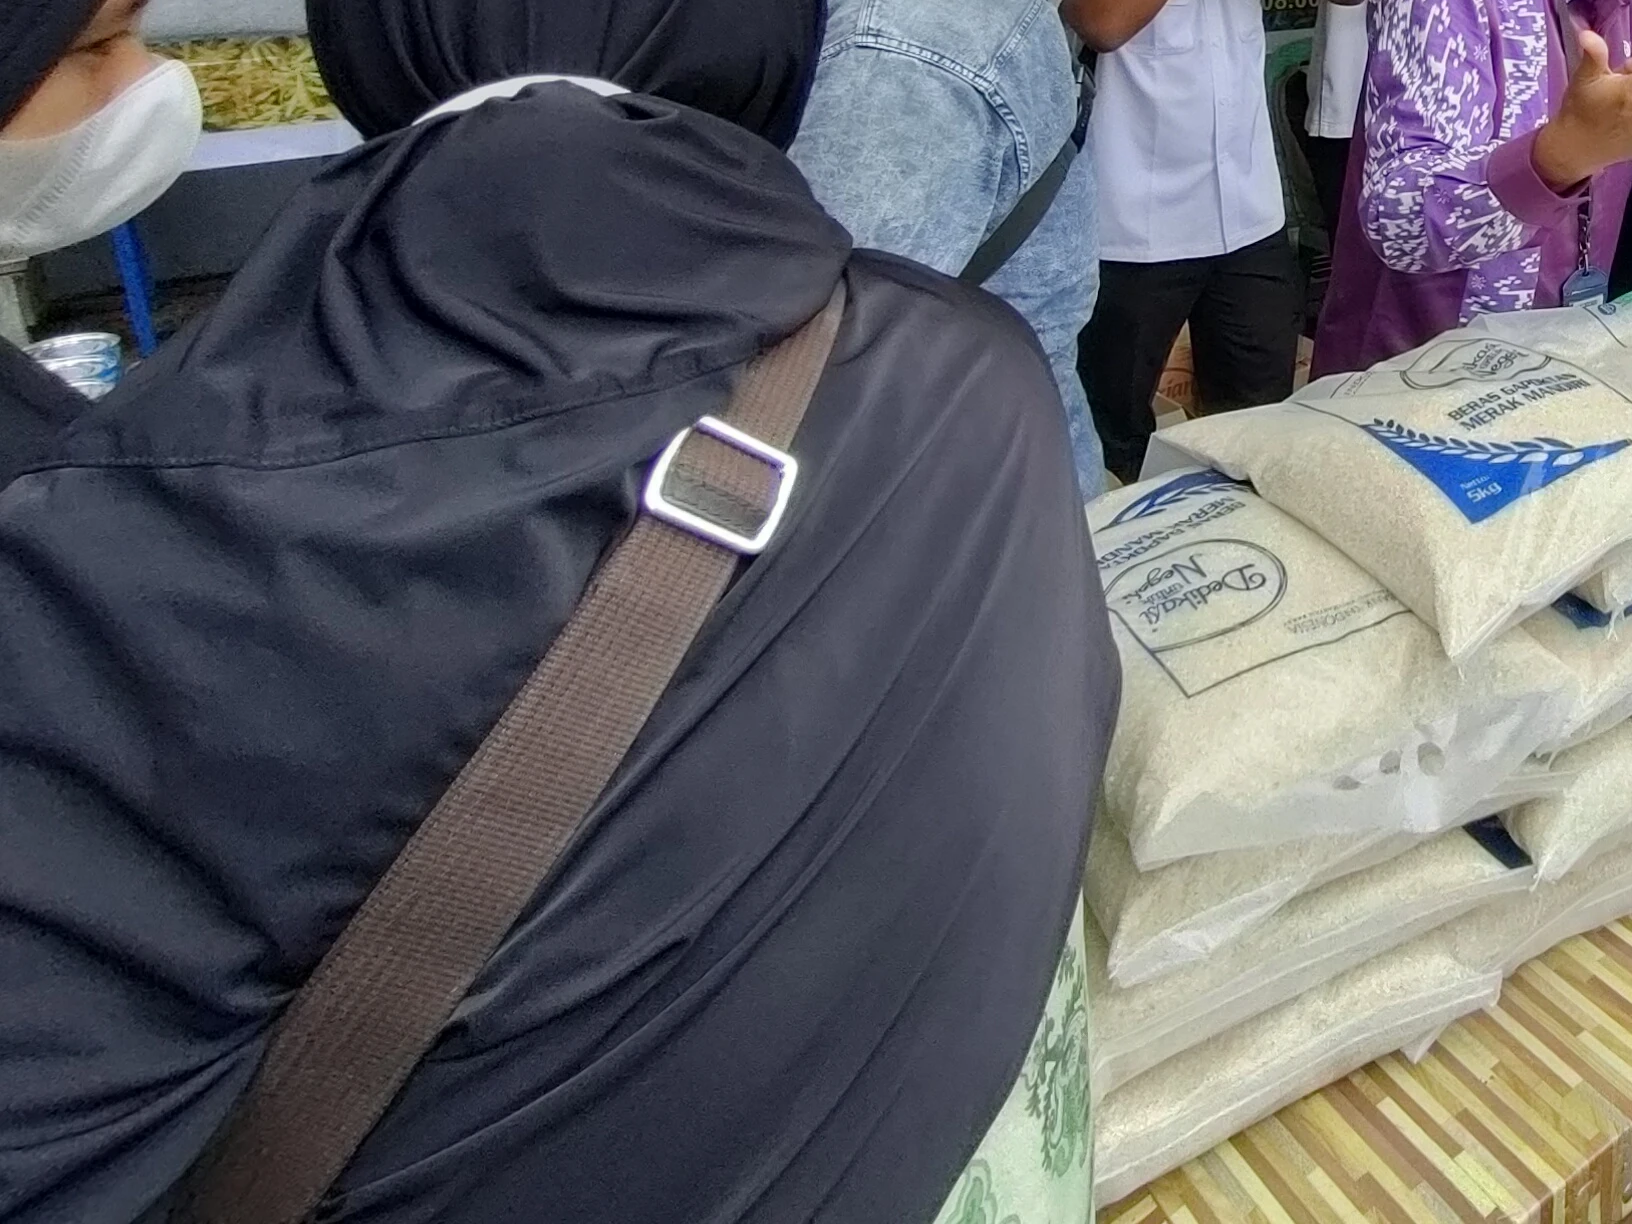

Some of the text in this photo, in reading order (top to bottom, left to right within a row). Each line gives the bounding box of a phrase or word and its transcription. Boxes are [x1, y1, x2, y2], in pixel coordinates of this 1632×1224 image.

[1448, 373, 1577, 421] BERAS GAPOKTAN
[1460, 379, 1591, 431] MERAK MANDIRI
[1139, 564, 1266, 633] Dedikasi
